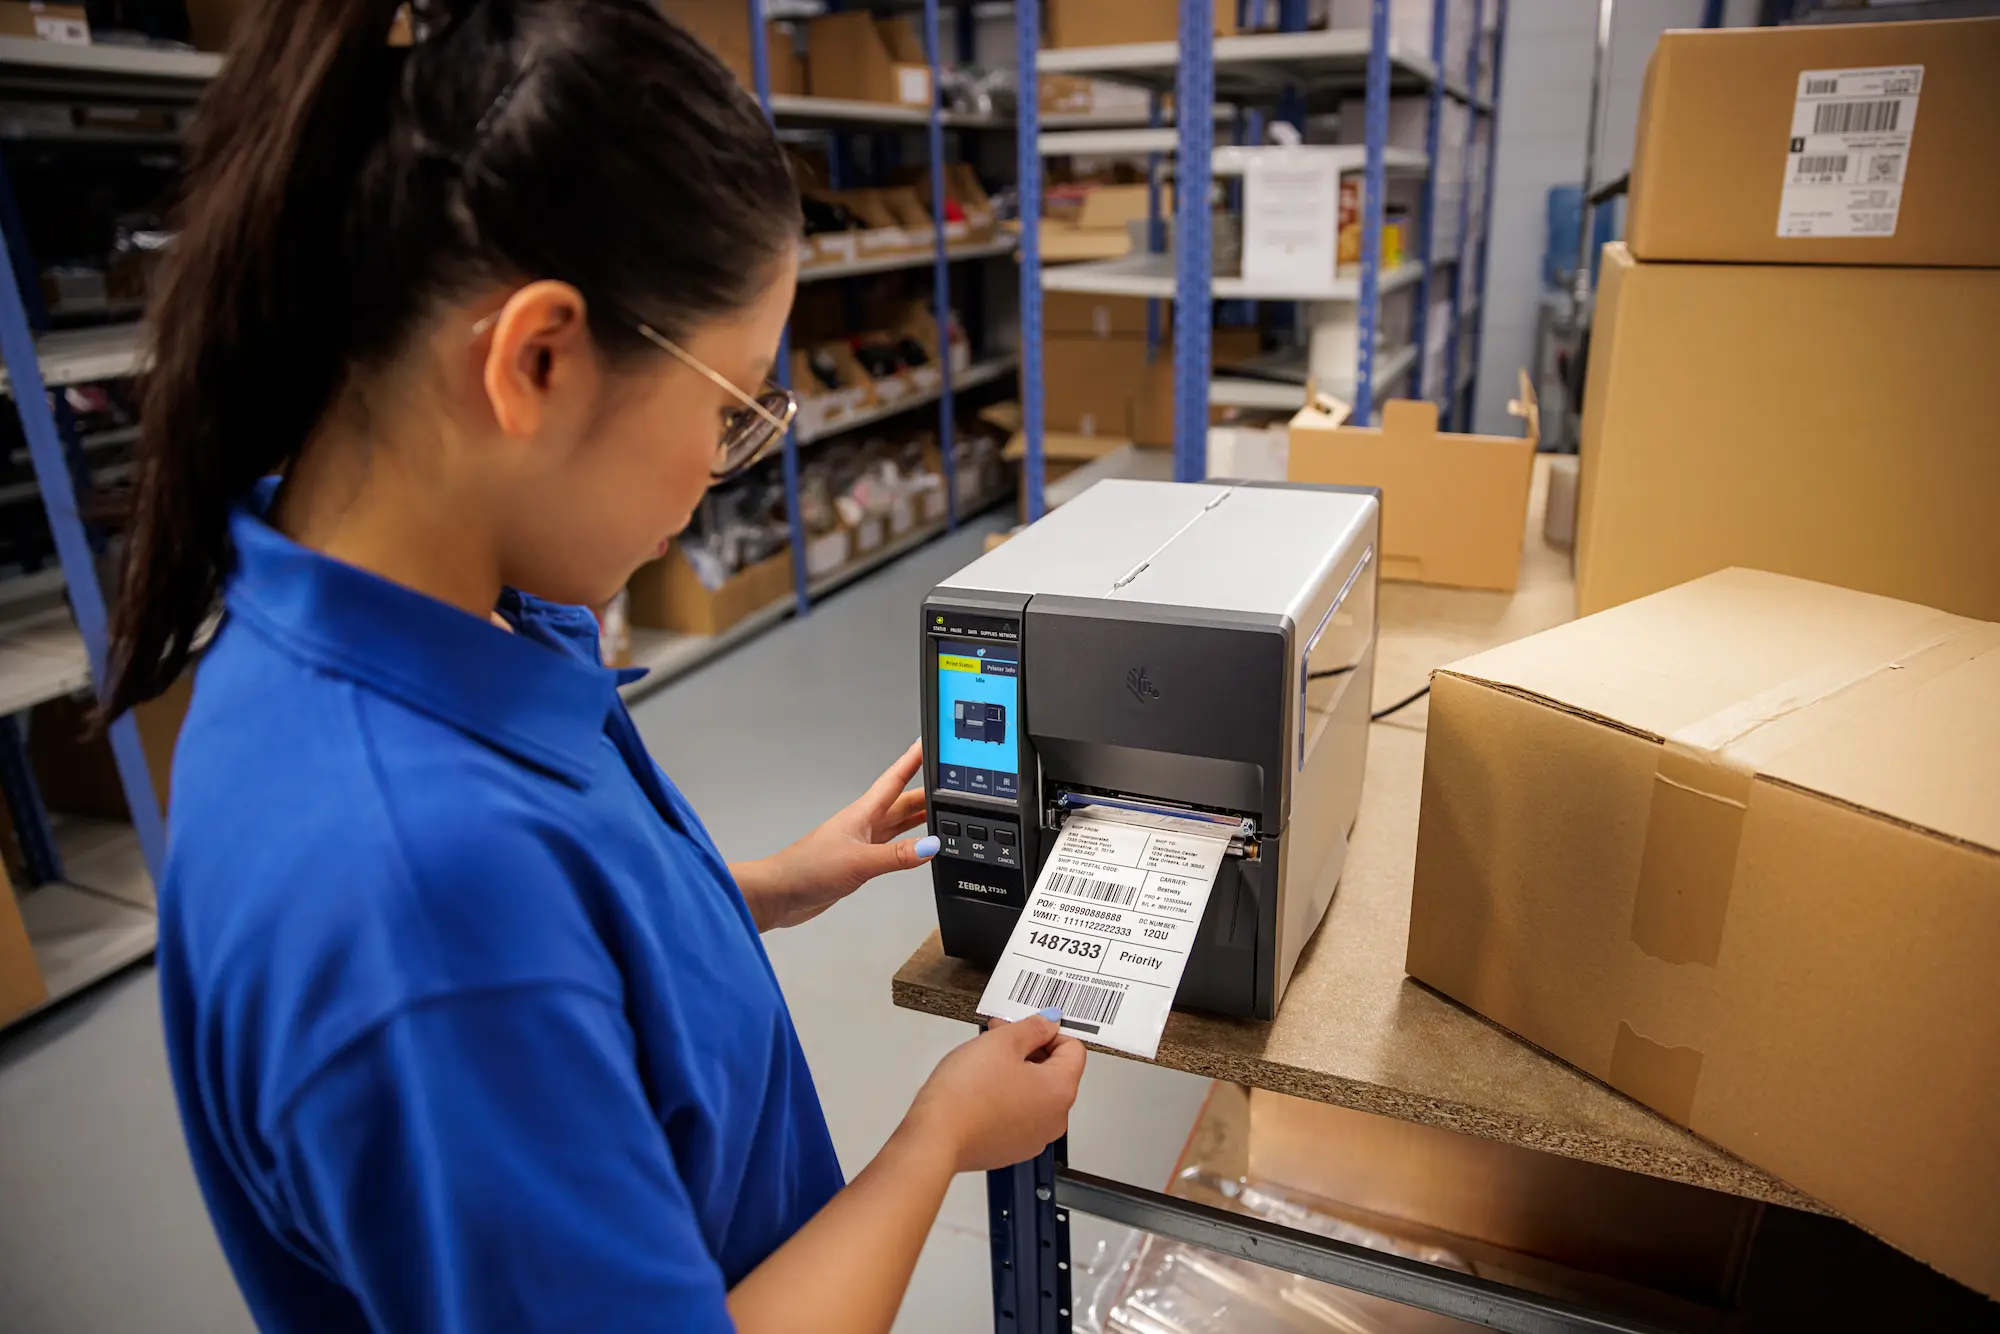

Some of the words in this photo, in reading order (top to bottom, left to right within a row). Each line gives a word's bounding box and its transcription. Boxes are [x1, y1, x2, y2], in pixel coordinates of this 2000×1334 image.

[996, 786, 1017, 794] Shortcuts
[1153, 846, 1180, 854] Distribution
[997, 856, 1014, 864] CANCEL
[1080, 861, 1101, 870] POSTAL
[1160, 877, 1188, 886] CARRIER:
[958, 881, 988, 893] ZEBRA
[988, 886, 1007, 895] ZT231
[1157, 886, 1181, 896] Bestway
[1036, 898, 1057, 909] PO#:
[1059, 903, 1122, 922] 909990888888
[1033, 909, 1060, 922] WMIT:
[1064, 916, 1132, 936] 1111122222333
[1149, 920, 1178, 930] NUMBER:
[1143, 929, 1169, 940] 12QU
[1029, 931, 1101, 959] 1487333
[1120, 951, 1162, 970] Priority
[1065, 973, 1090, 982] 1222233
